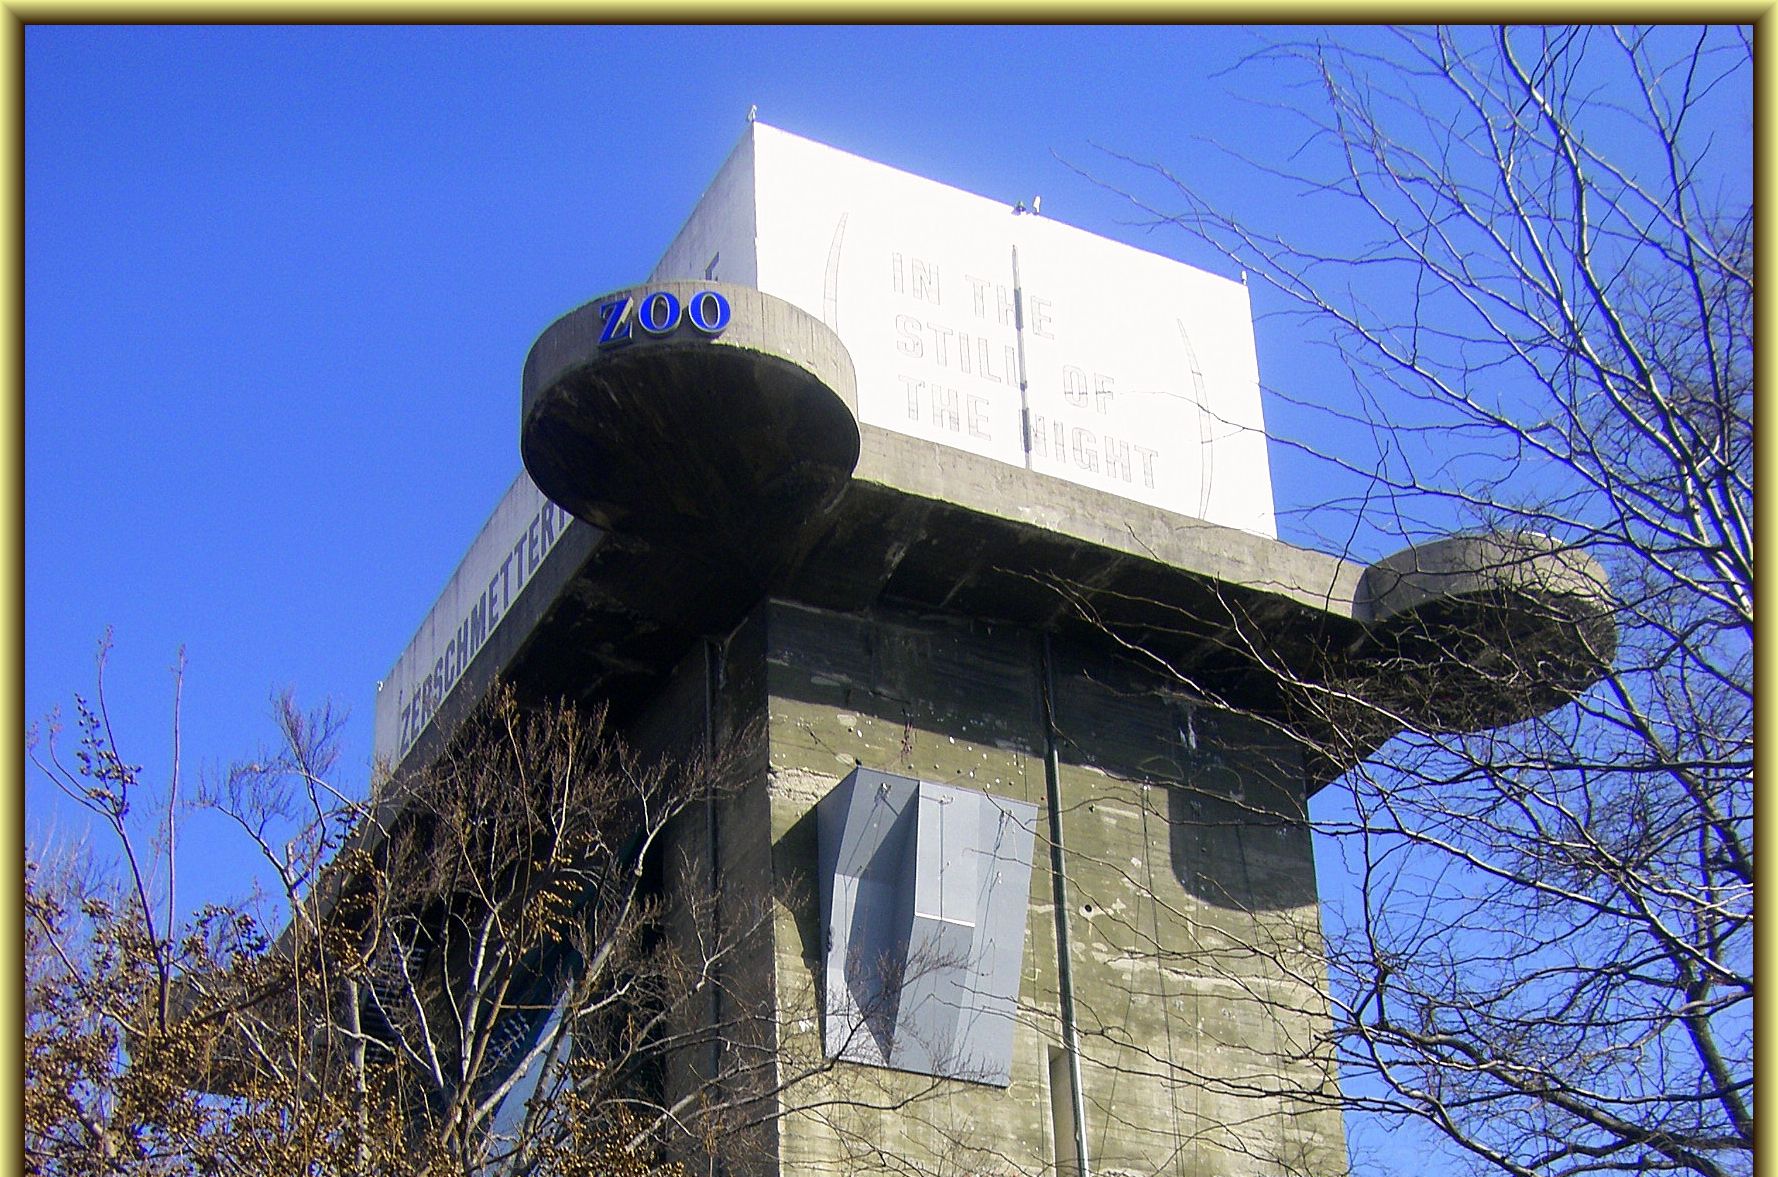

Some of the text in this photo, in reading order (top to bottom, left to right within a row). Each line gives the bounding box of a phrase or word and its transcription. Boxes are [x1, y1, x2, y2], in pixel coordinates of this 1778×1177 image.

[599, 290, 732, 346] ZOO
[892, 251, 1055, 341] IN THE
[896, 314, 1115, 416] STILL OF
[898, 374, 1159, 490] THE NIGHT
